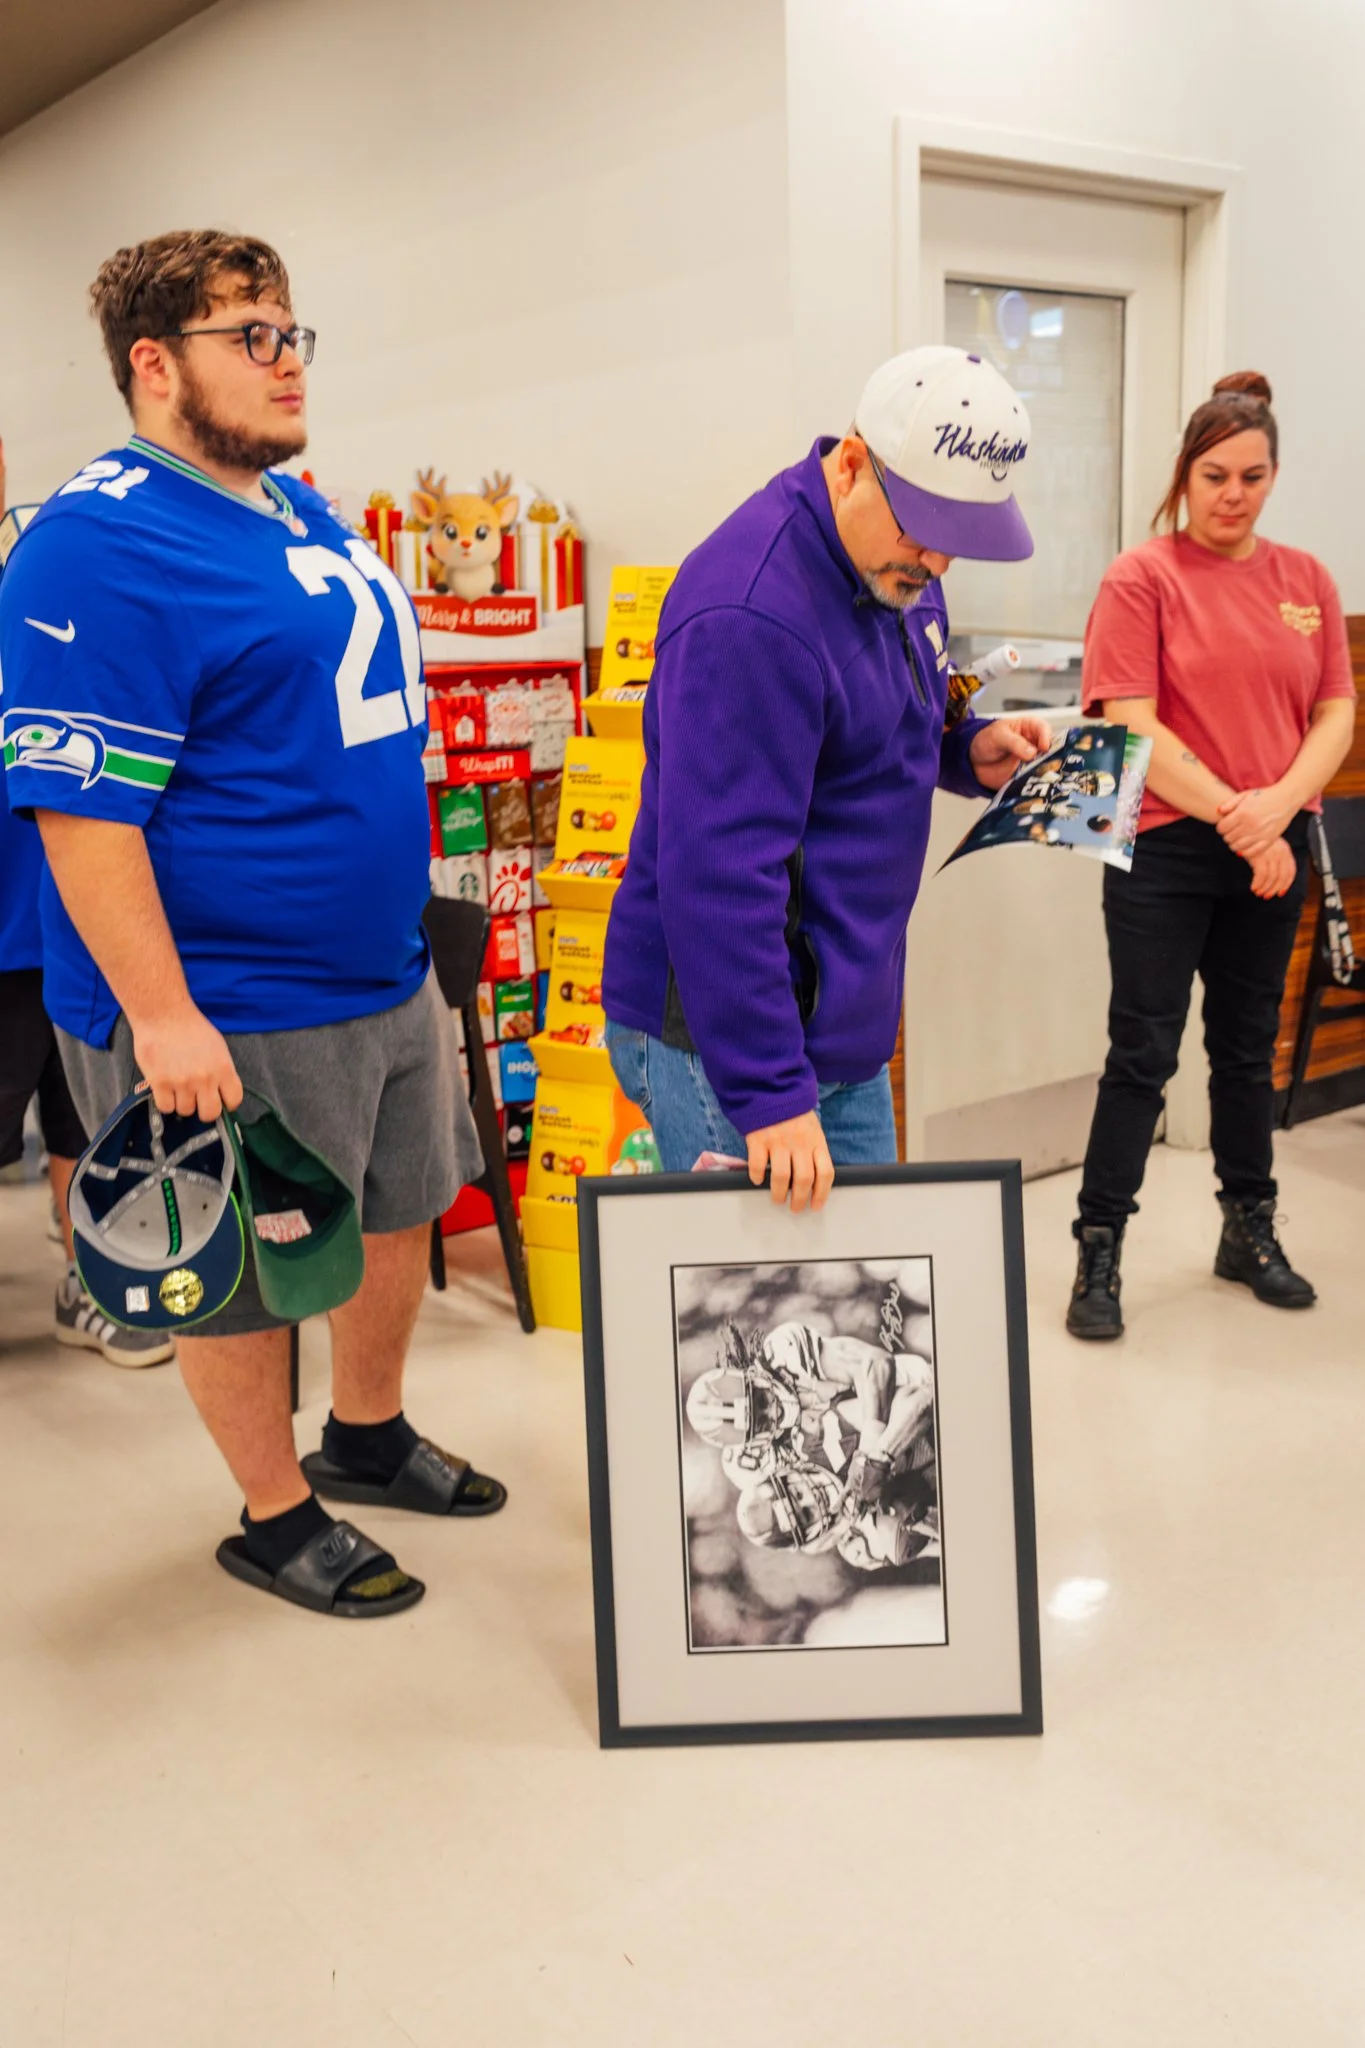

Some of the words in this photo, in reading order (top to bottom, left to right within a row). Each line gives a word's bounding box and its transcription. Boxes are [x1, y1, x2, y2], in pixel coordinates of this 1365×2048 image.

[58, 460, 150, 500] 21
[417, 604, 458, 632] Merry
[460, 607, 472, 625] &
[474, 608, 531, 626] BRIGHT
[285, 539, 427, 749] 21
